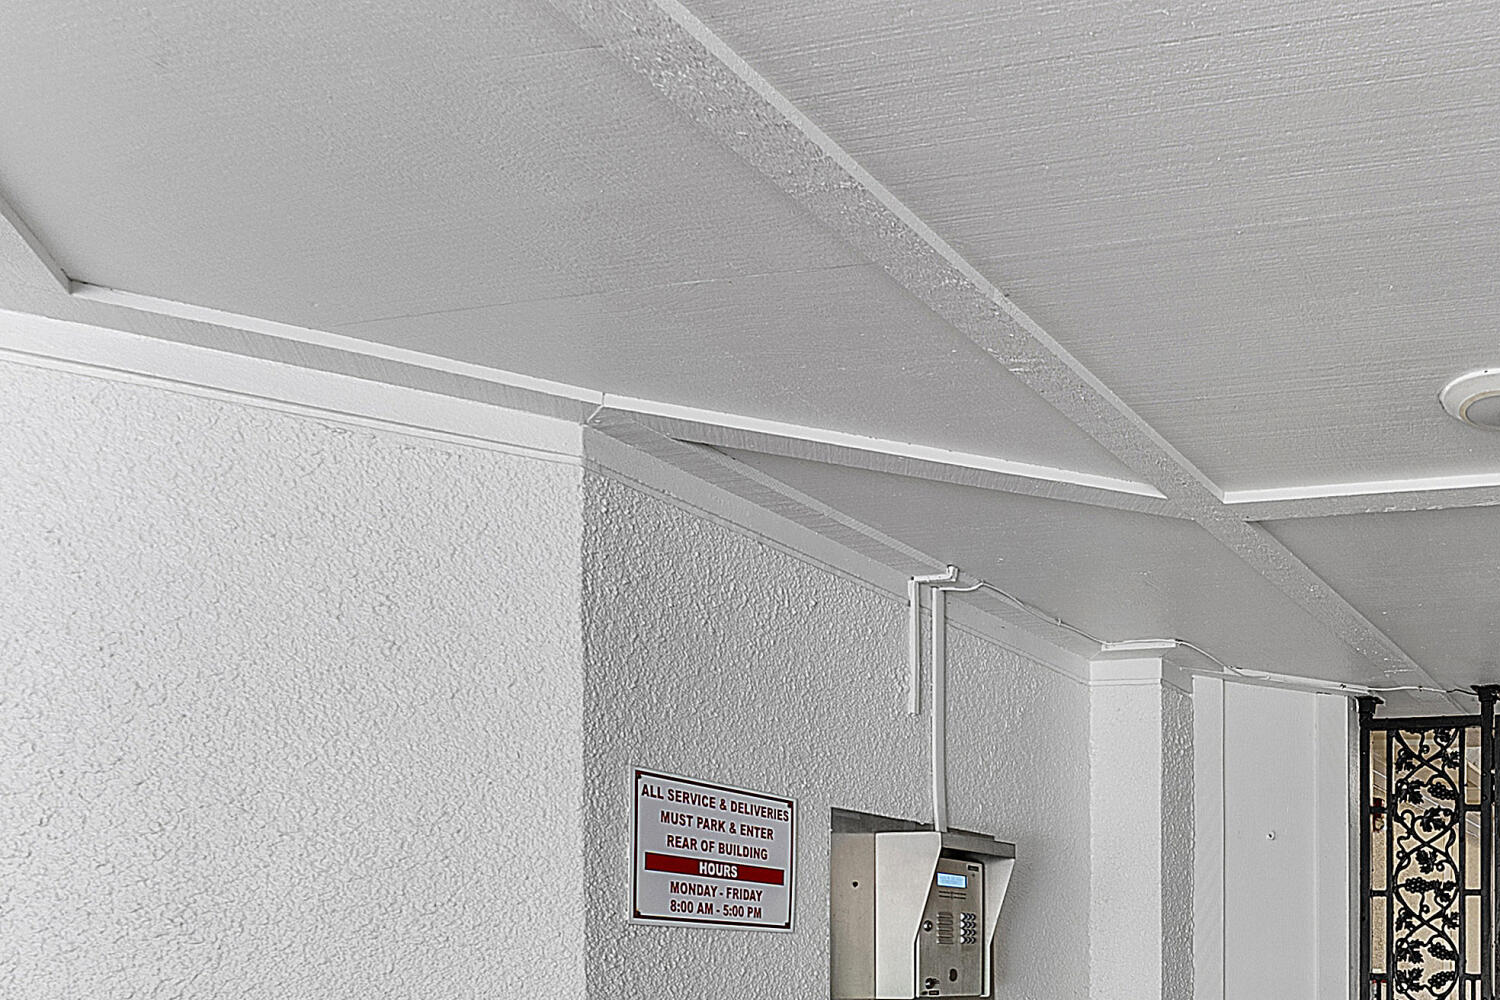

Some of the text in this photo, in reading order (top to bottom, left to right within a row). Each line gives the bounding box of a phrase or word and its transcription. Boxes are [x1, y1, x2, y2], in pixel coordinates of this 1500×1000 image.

[641, 784, 789, 821] ALL SERVICE & DELIVERIES
[660, 810, 773, 840] MUST PARK & ENTER
[667, 835, 768, 860] REAR OF BUILDING
[699, 862, 737, 877] HOURS
[670, 881, 717, 898] MONDAY
[727, 888, 762, 902] FRIDAY
[670, 900, 693, 913] 8:00
[697, 902, 713, 915] AM
[723, 905, 744, 917] 5:00
[748, 907, 763, 919] PM
